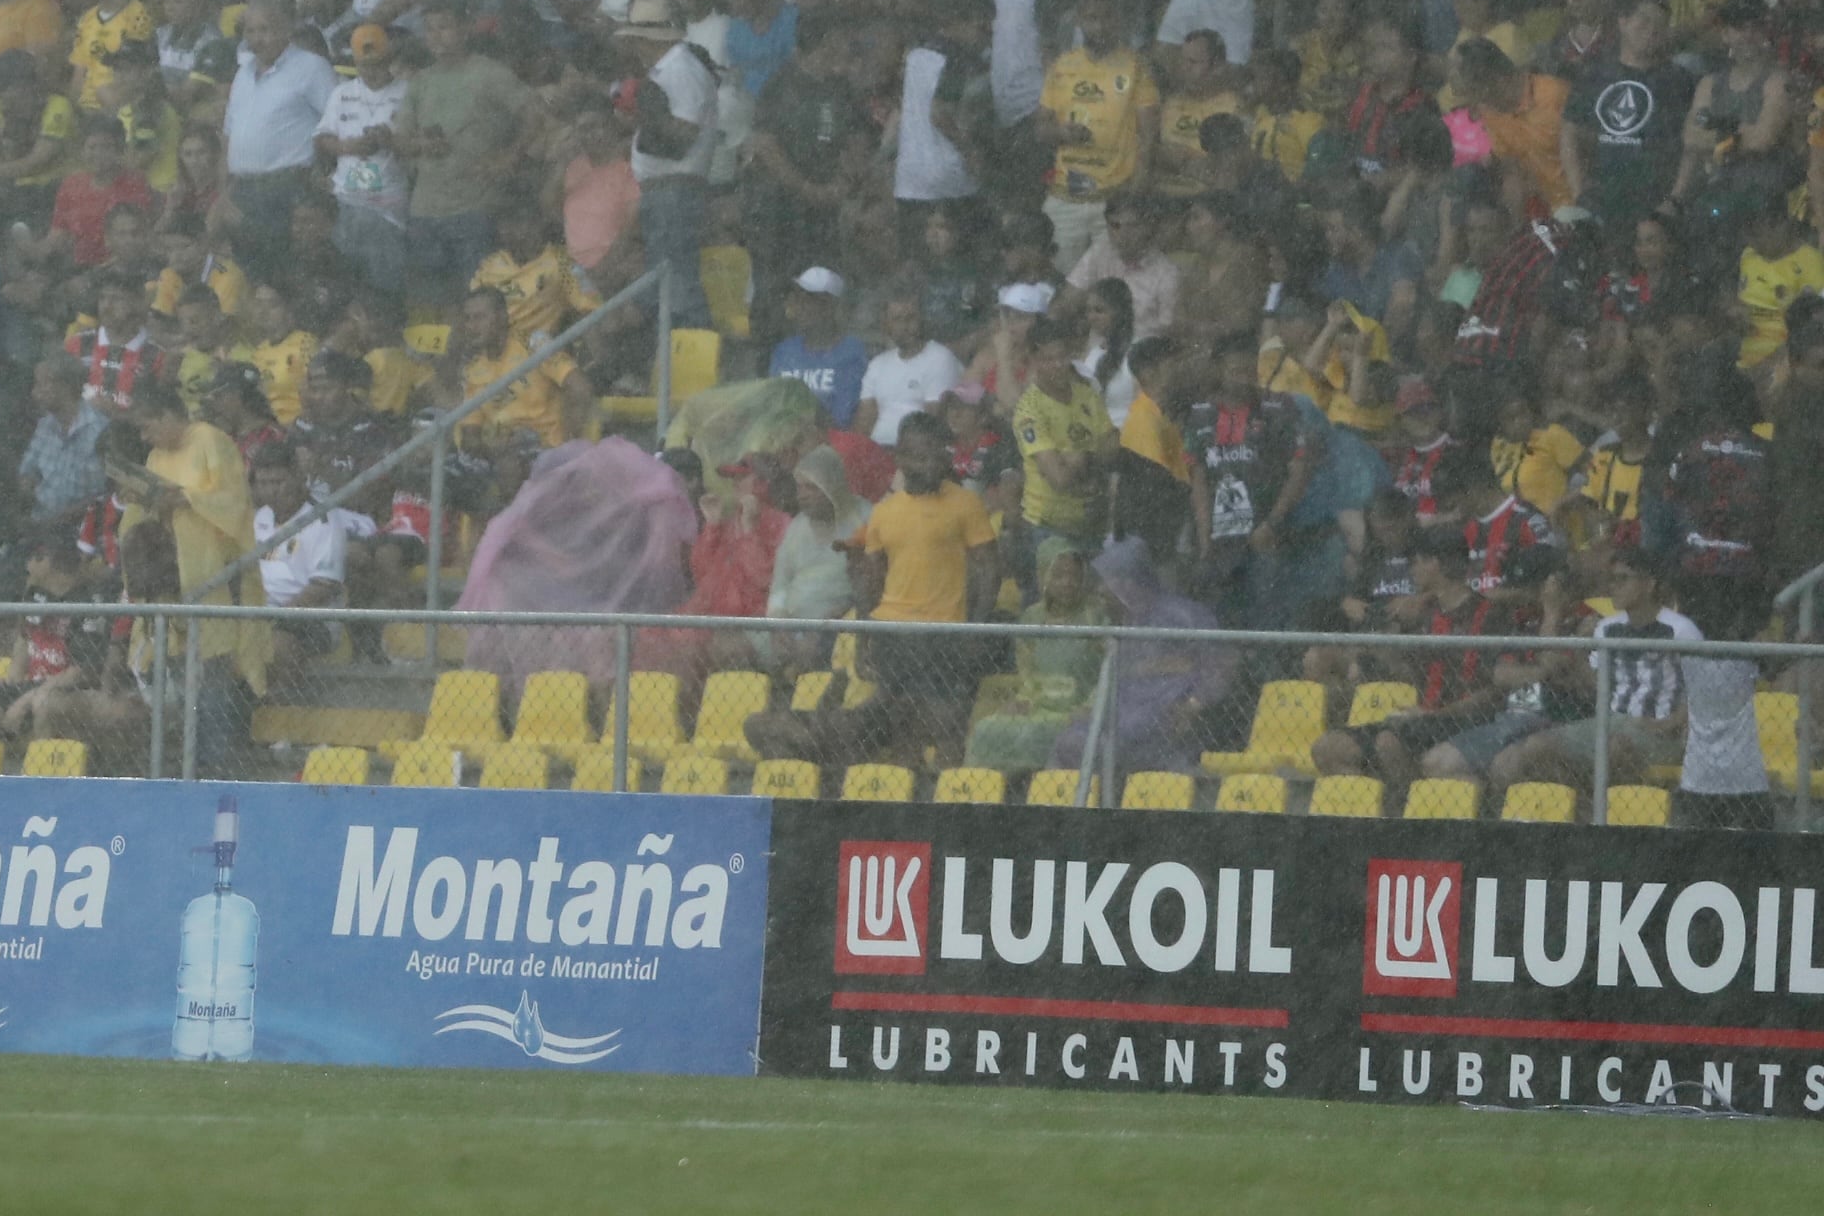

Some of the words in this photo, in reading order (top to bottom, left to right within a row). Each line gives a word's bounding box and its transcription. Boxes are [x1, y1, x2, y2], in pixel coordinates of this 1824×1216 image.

[331, 825, 730, 949] Montaña
[940, 856, 1292, 974] LUKOIL
[405, 949, 460, 981] Agua
[465, 951, 514, 977] Pura
[520, 952, 546, 977] de
[551, 954, 658, 982] Manantial
[1472, 877, 1824, 994] LUKOIL
[188, 1001, 237, 1018] Montaña
[829, 1024, 1288, 1090] LUBRICANTS
[1358, 1046, 1824, 1113] LUBRICANTS
